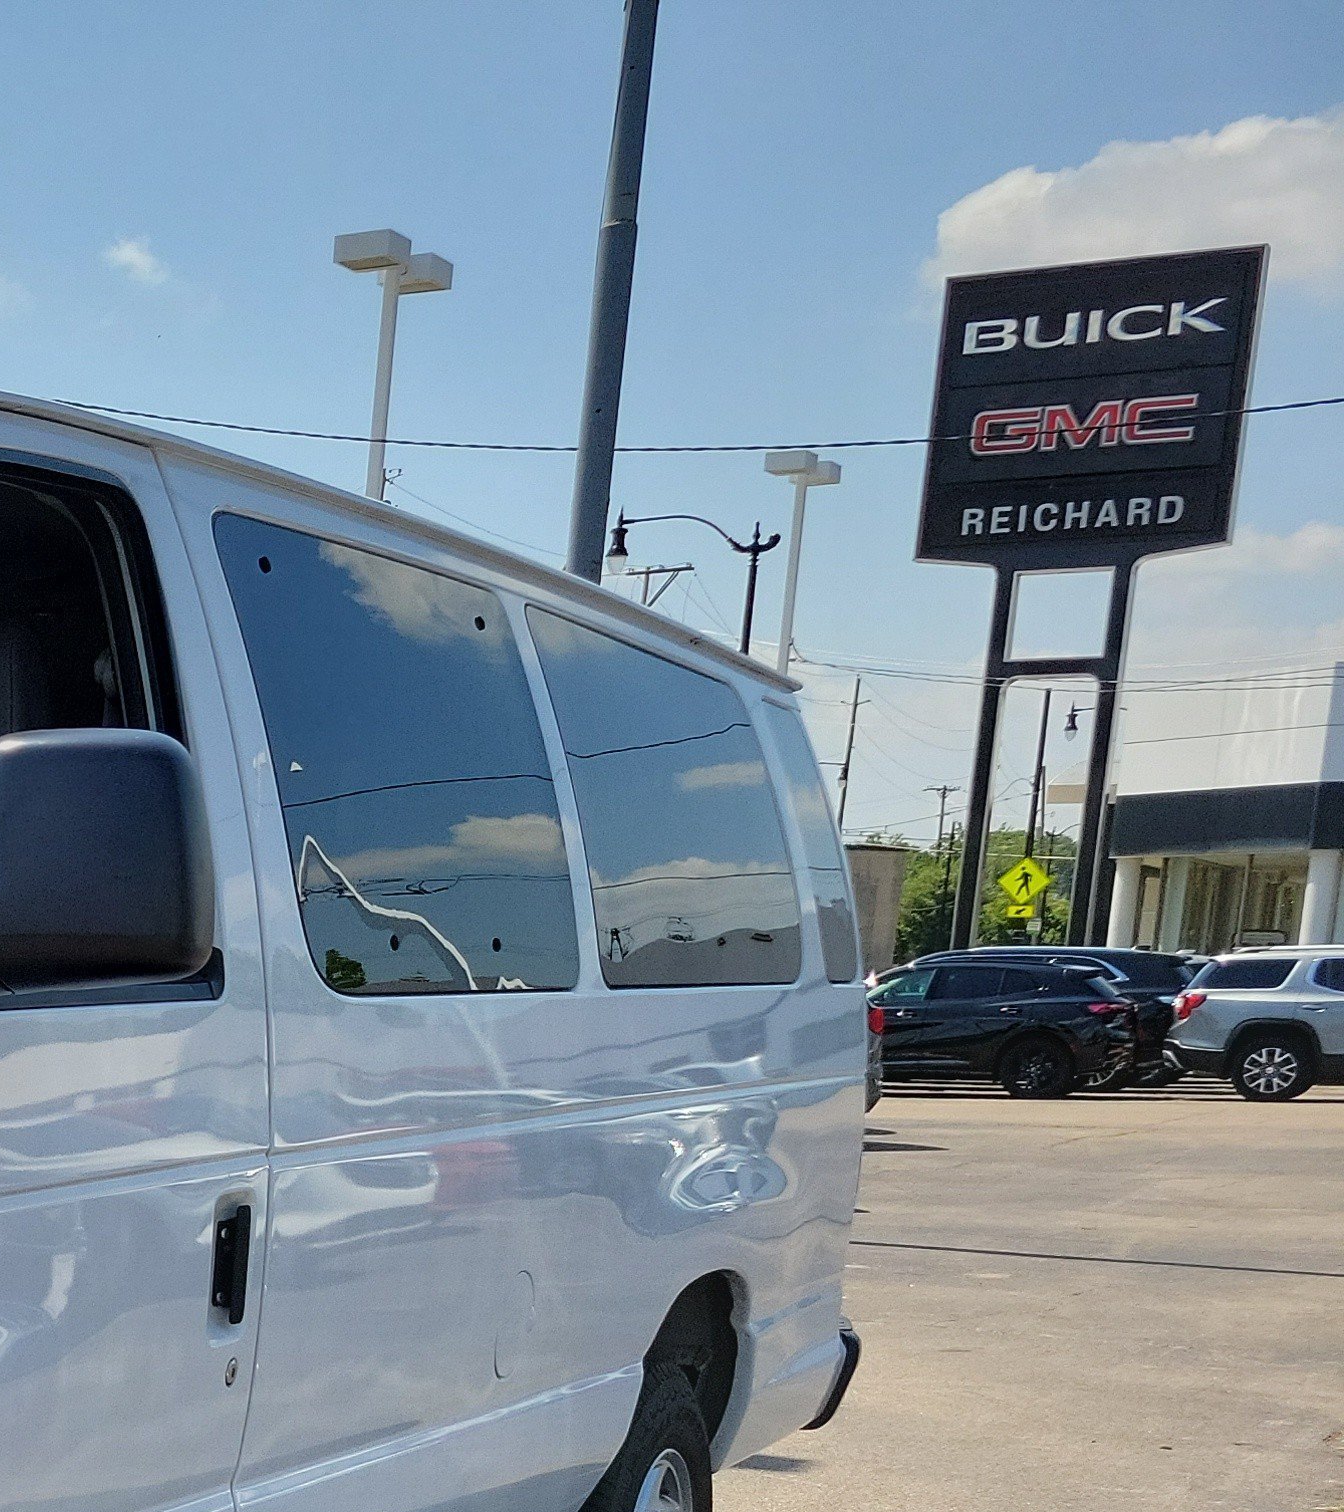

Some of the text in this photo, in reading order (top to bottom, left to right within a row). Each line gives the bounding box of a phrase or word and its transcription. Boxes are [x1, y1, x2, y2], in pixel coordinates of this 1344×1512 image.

[962, 298, 1227, 354] BUICK
[971, 393, 1199, 455] GMC
[961, 496, 1184, 535] REICHARD
